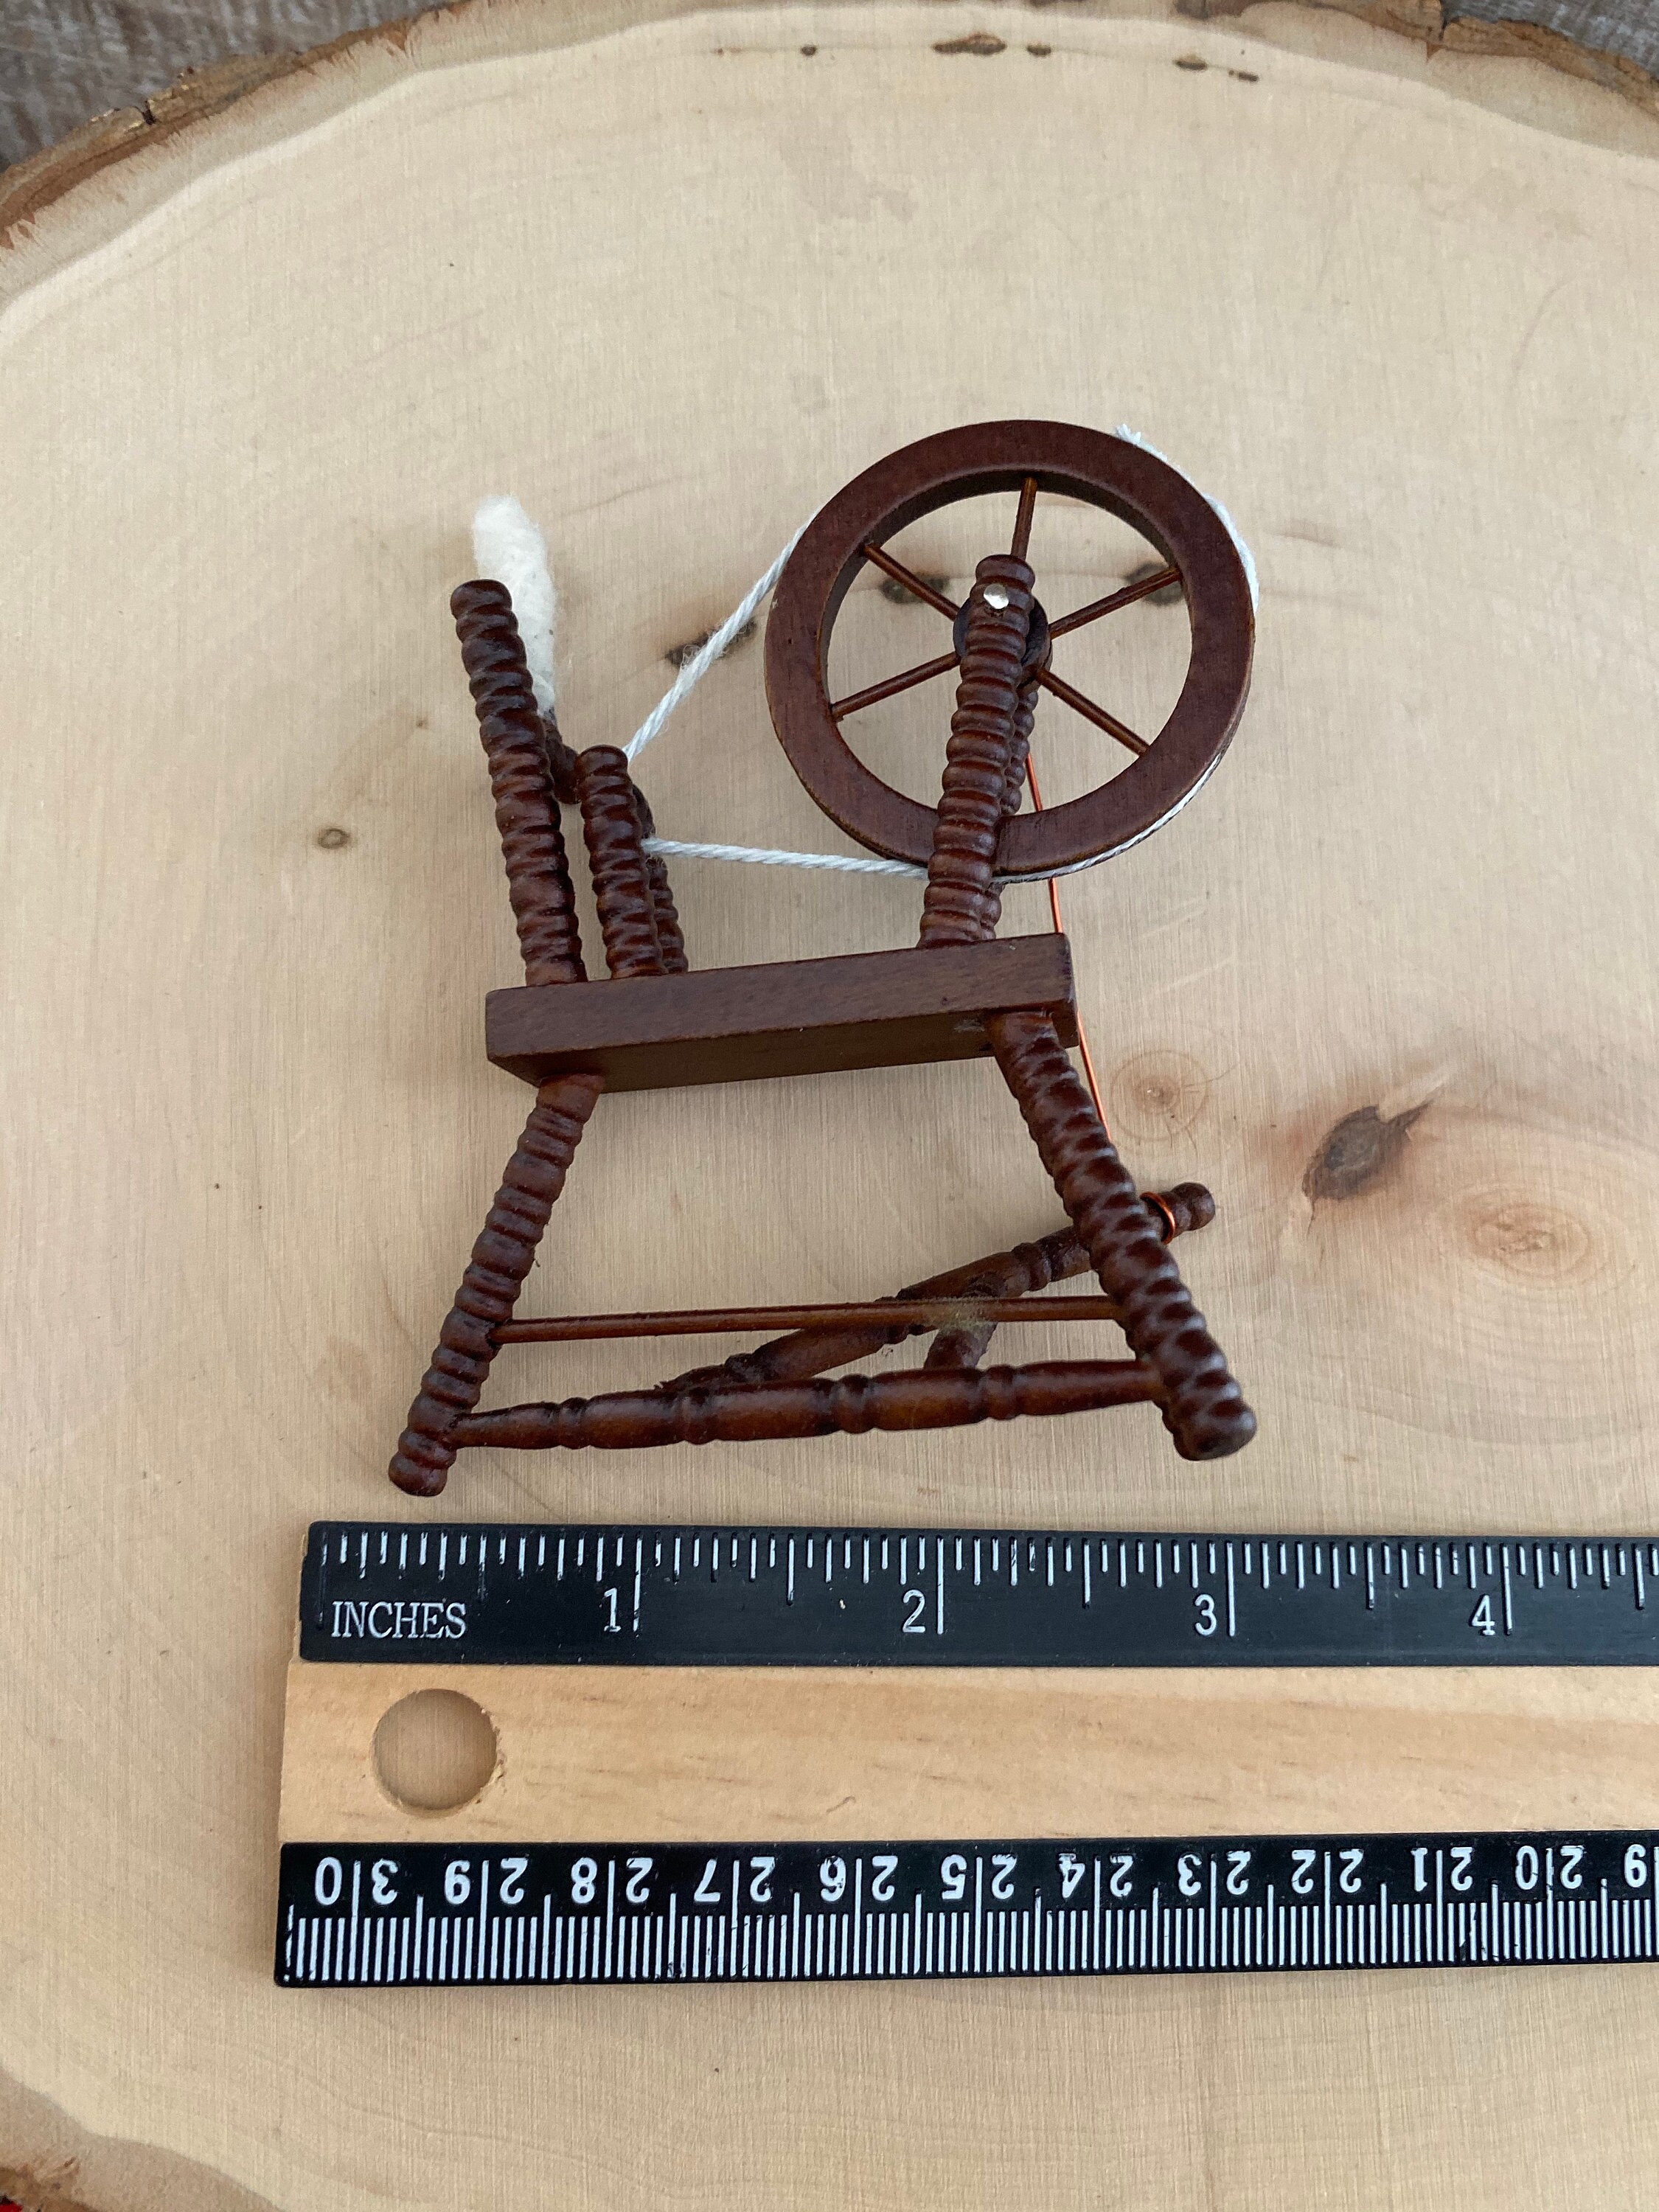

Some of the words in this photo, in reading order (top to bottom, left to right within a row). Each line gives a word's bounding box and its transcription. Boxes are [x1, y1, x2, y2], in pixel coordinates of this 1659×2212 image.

[331, 1601, 467, 1639] INCHES
[604, 1587, 622, 1633] 1
[902, 1589, 926, 1634] 2
[1194, 1594, 1217, 1636] 3
[1472, 1594, 1496, 1636] 4
